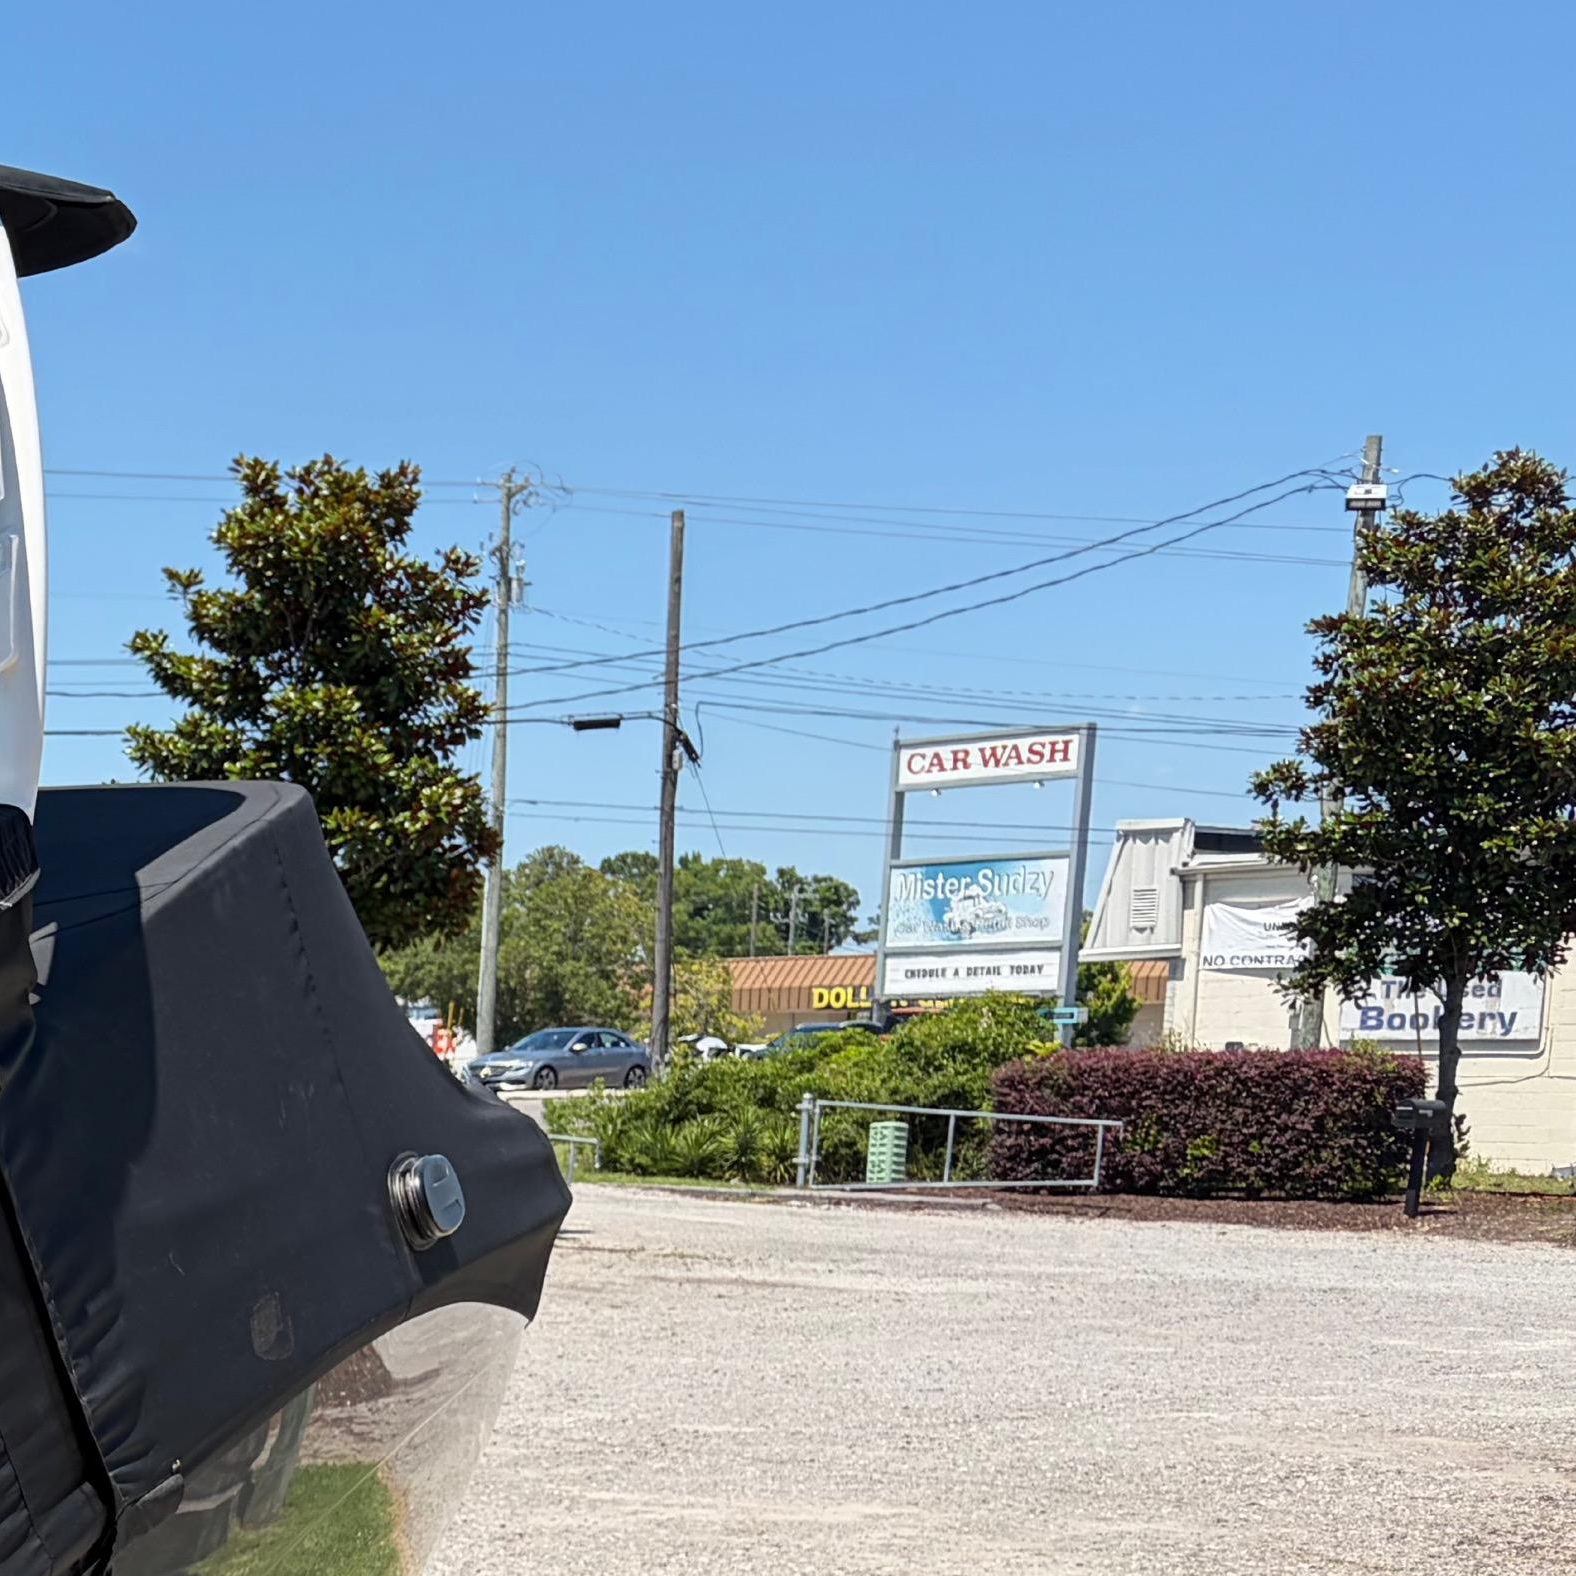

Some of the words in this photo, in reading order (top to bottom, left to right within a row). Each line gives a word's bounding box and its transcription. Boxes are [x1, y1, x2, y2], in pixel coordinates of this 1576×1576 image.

[907, 749, 972, 775] CAR
[978, 740, 1073, 768] WASH
[896, 872, 973, 900] Mister
[978, 865, 1054, 899] Sudzy
[953, 967, 960, 977] A
[966, 964, 1002, 977] DETAIL
[1009, 963, 1045, 976] TODAY
[1203, 954, 1225, 967] NO
